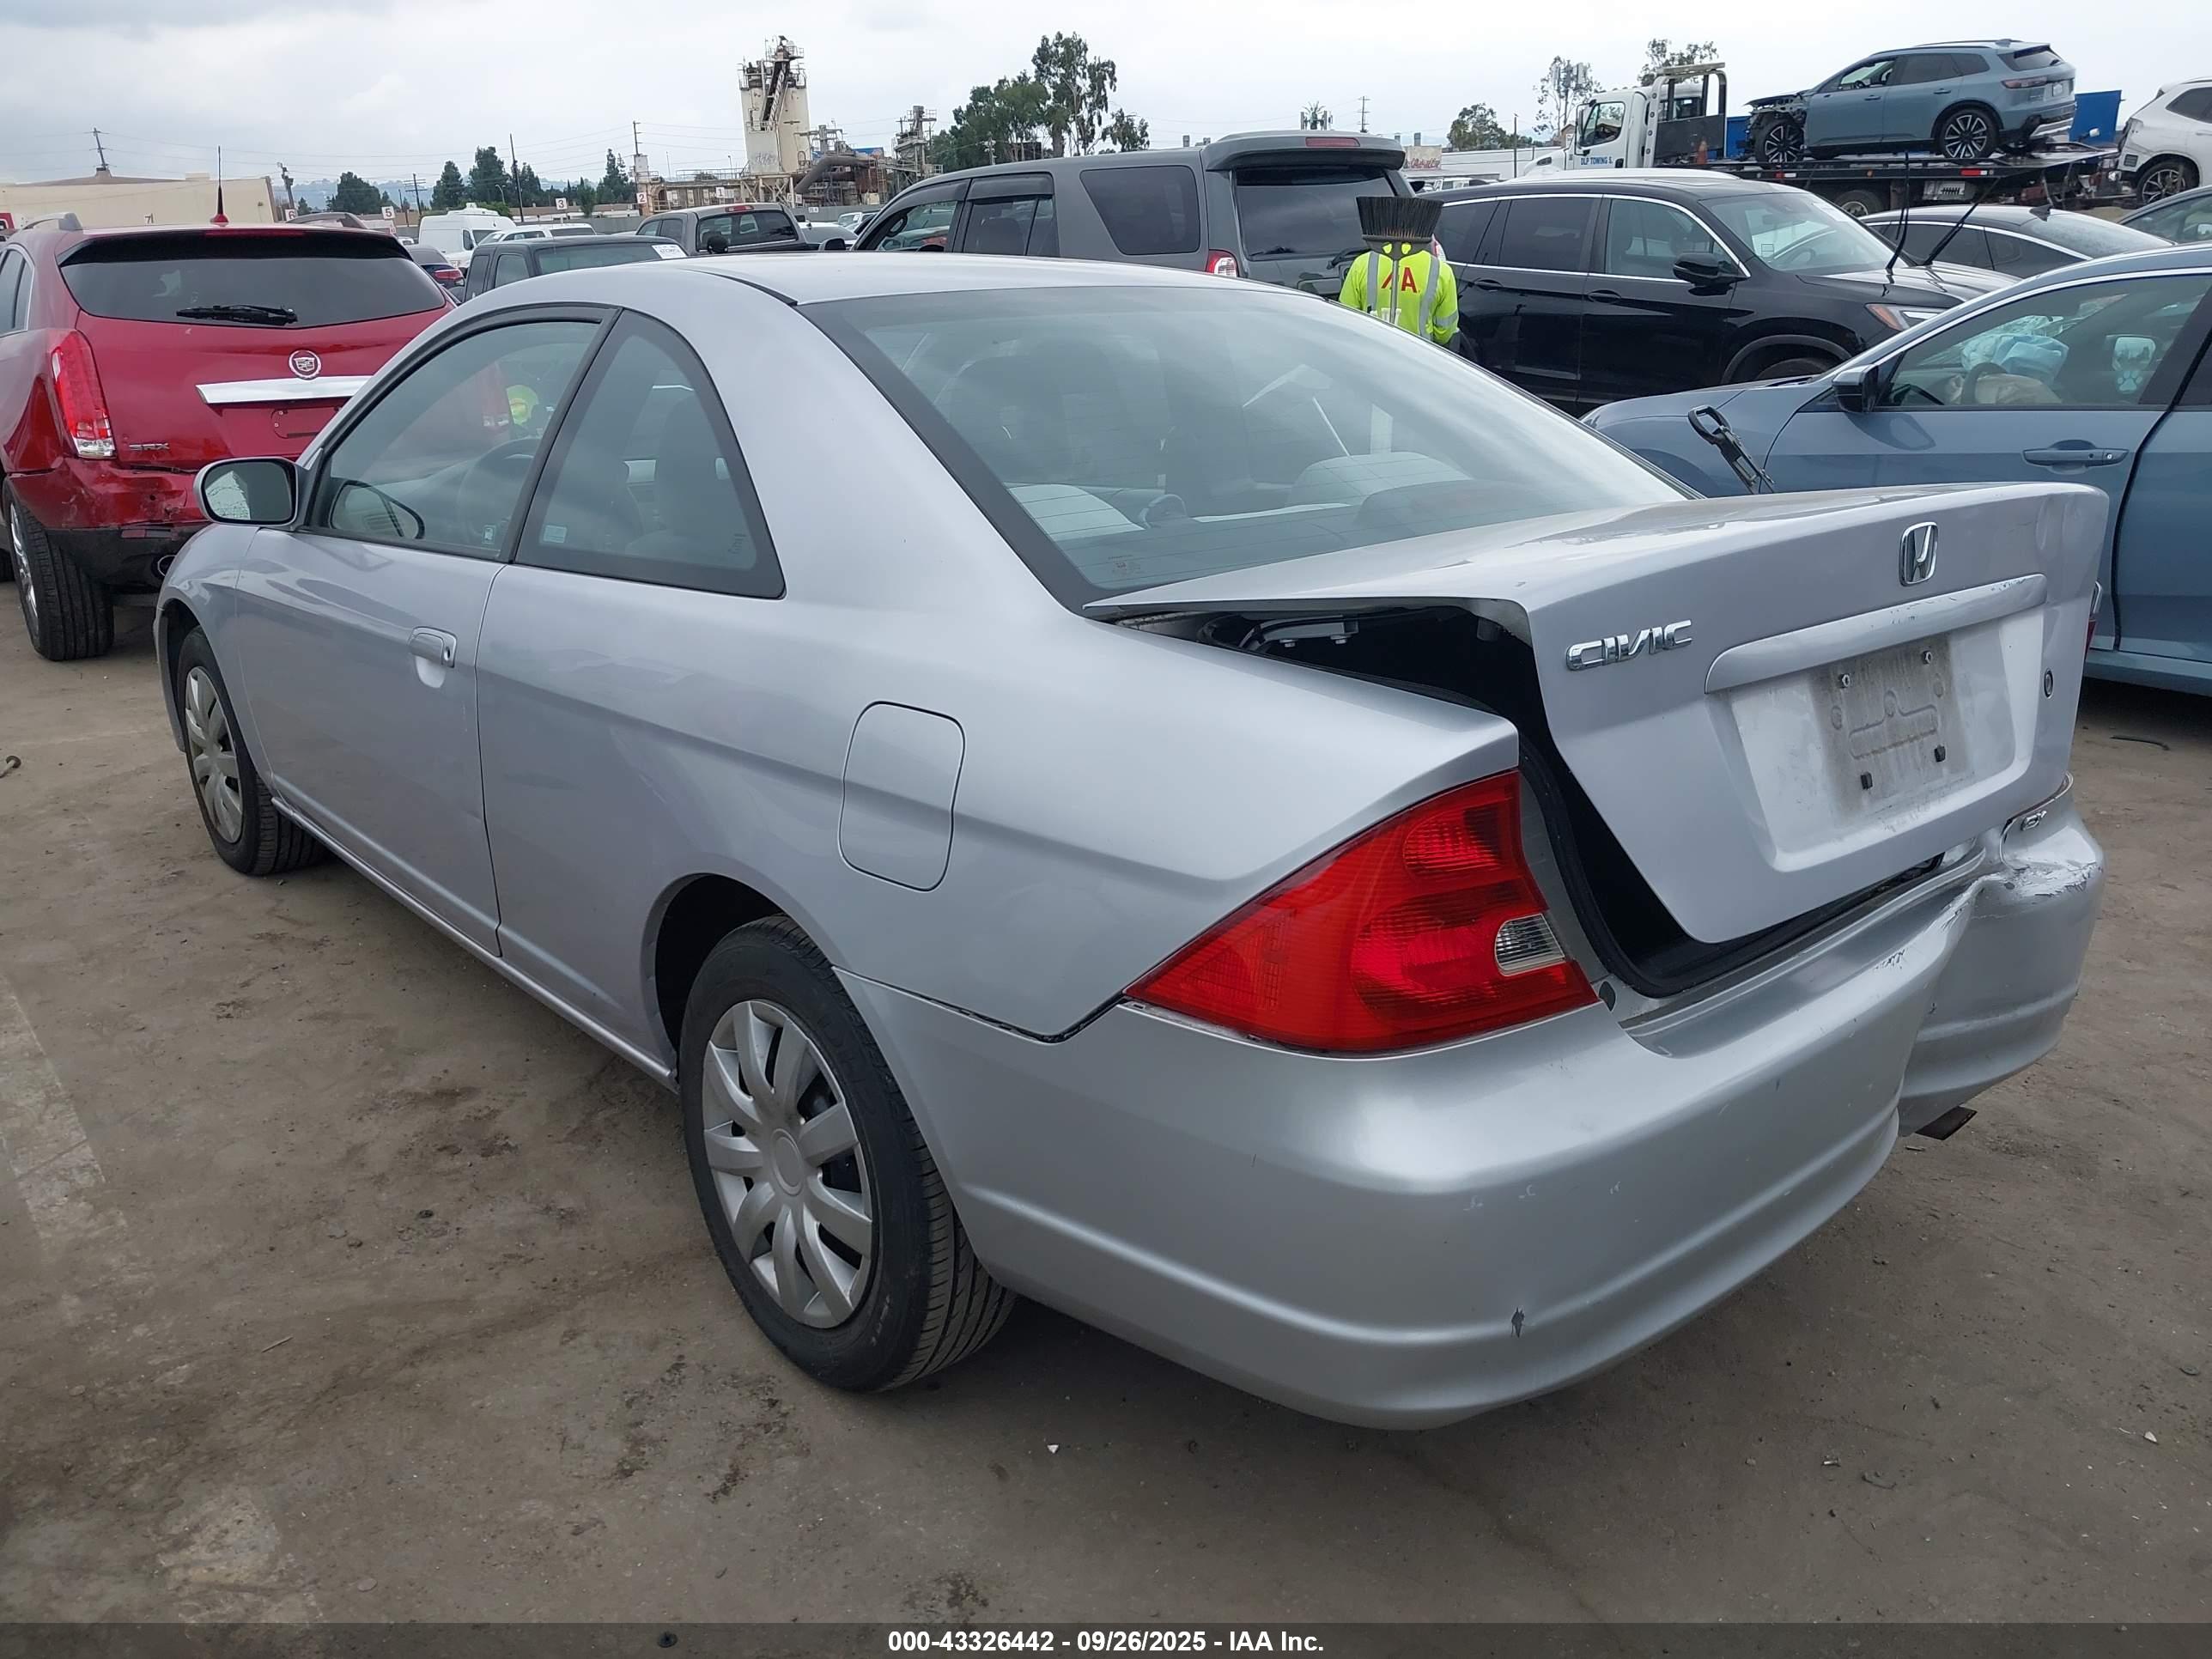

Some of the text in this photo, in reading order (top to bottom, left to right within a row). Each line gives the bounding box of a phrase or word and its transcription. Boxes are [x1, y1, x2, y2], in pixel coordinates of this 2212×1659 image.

[638, 193, 646, 203] 2
[557, 199, 565, 209] 3
[385, 208, 392, 217] 5
[1566, 618, 1693, 671] CIVIC
